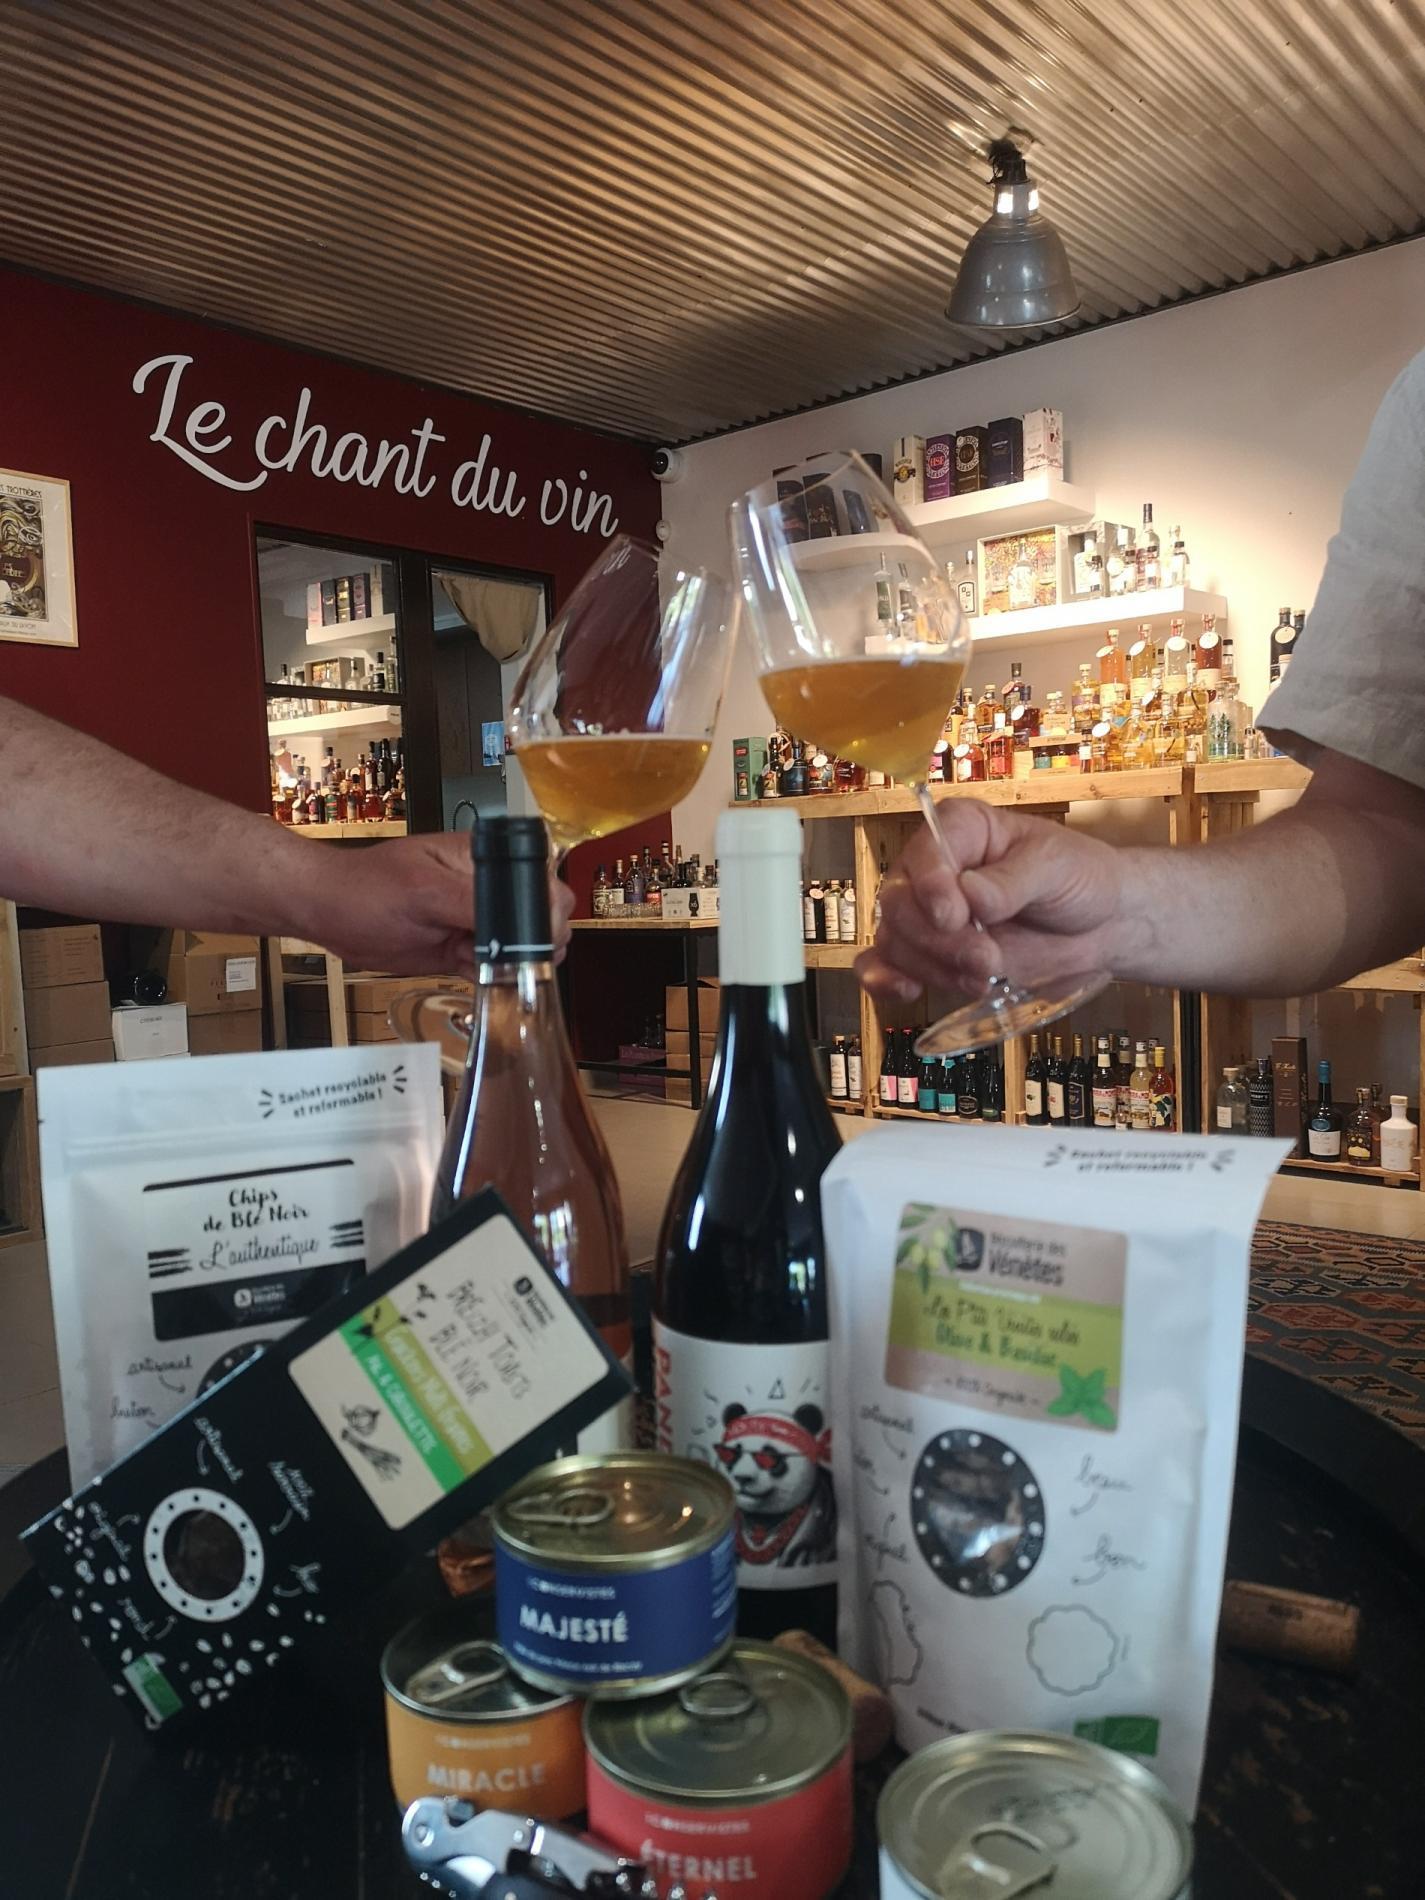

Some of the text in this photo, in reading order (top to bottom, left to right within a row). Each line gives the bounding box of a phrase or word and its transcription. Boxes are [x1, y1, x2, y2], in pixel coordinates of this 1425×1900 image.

[133, 354, 619, 537] Le chant du vin
[227, 1188, 279, 1215] Chips
[203, 1215, 226, 1233] de
[269, 1203, 310, 1224] Noir
[199, 1234, 320, 1269] L'authentique
[520, 1604, 629, 1644] MAJESTÉ
[427, 1763, 546, 1793] MIRACLE
